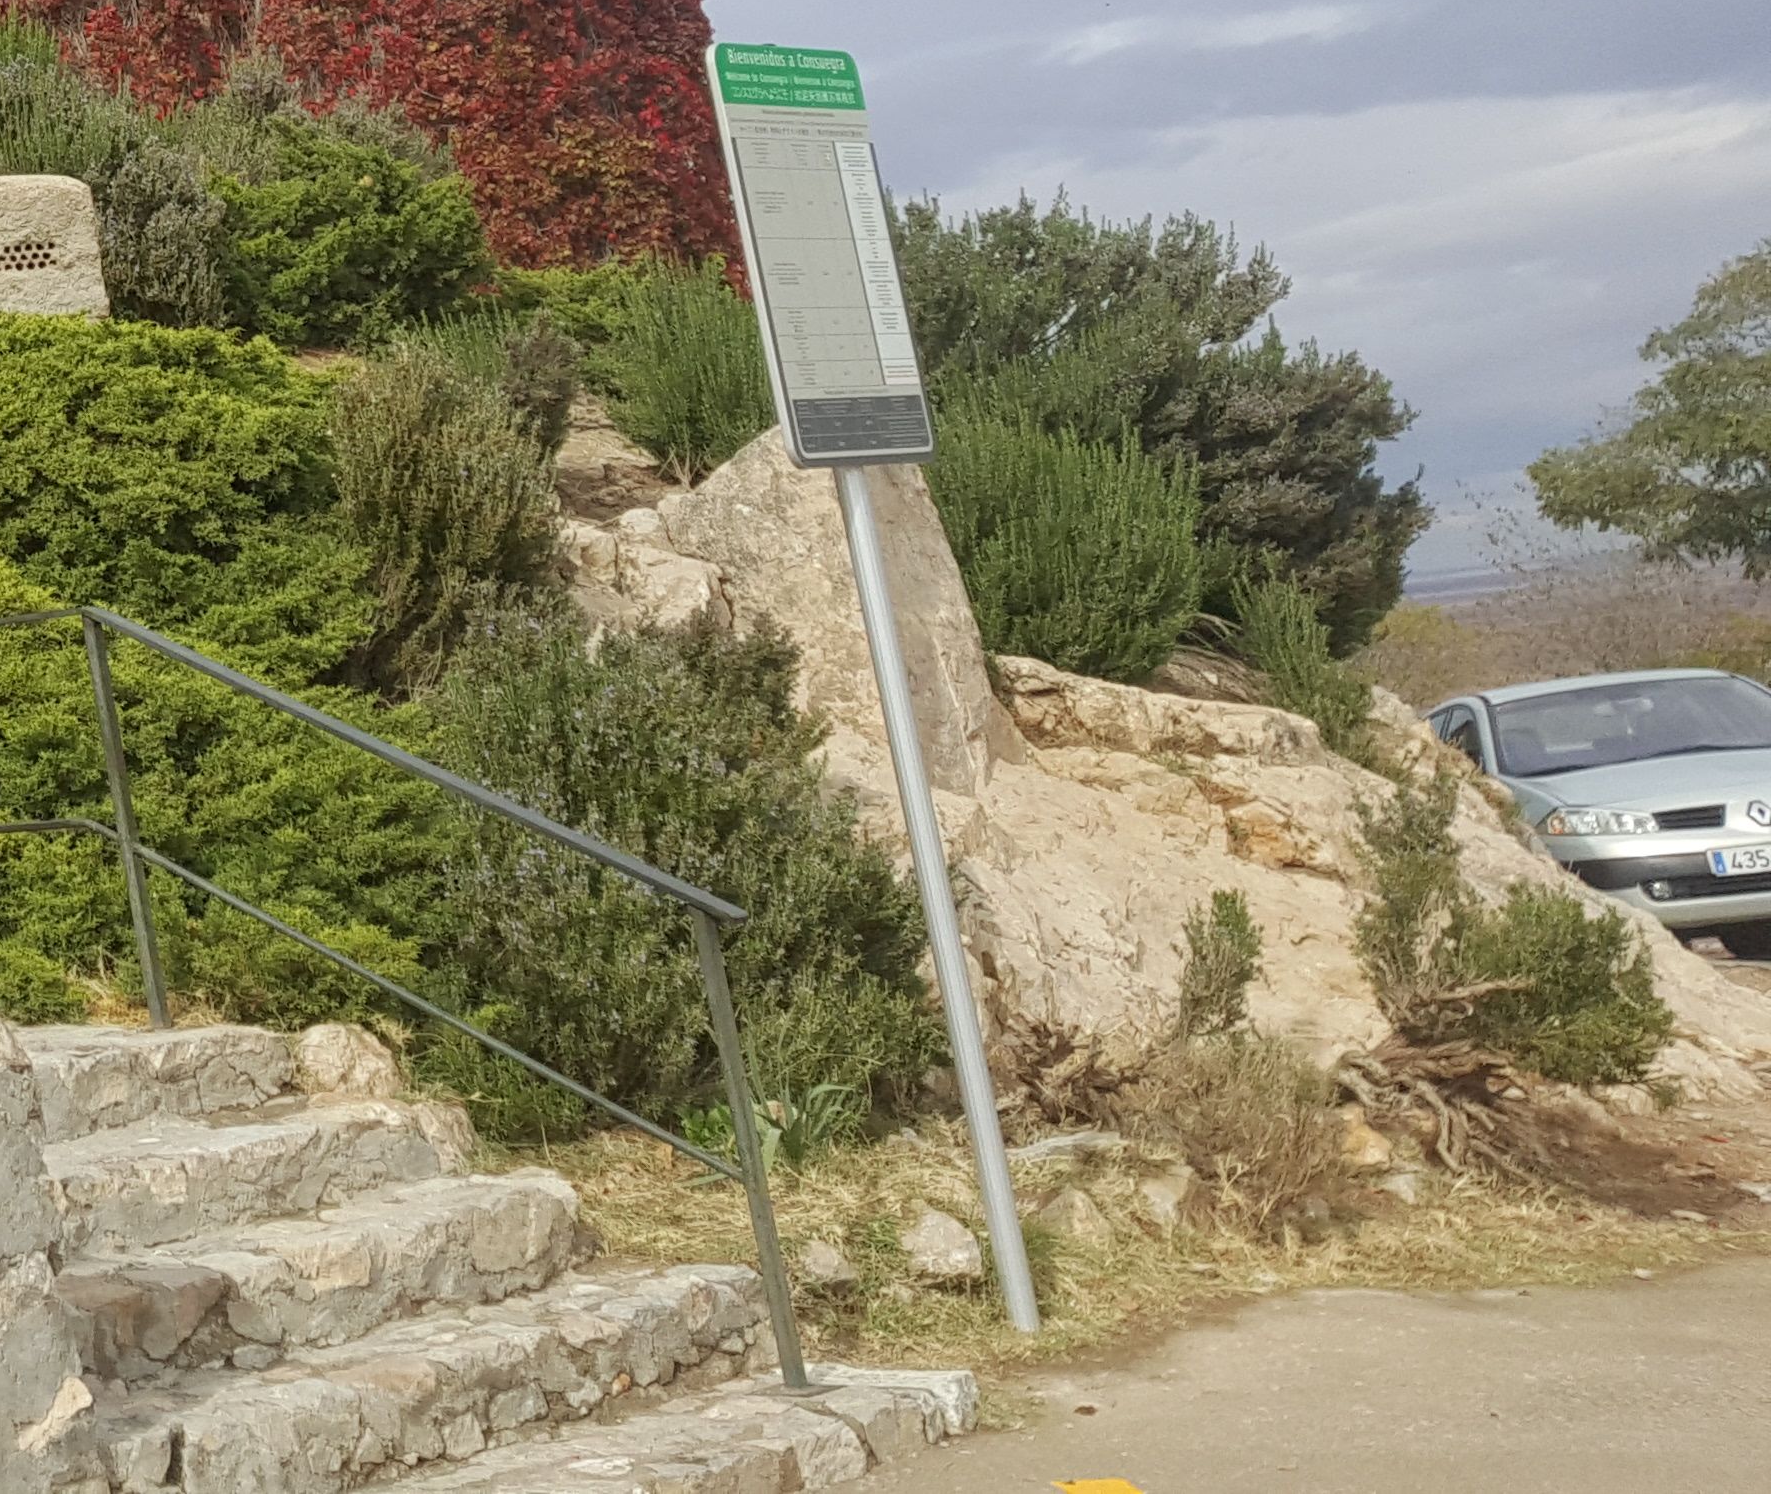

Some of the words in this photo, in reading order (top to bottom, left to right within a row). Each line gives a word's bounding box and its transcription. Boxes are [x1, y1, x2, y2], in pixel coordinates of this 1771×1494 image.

[727, 48, 786, 67] Bienvenidos
[788, 55, 796, 68] a
[797, 53, 847, 75] Consuegra
